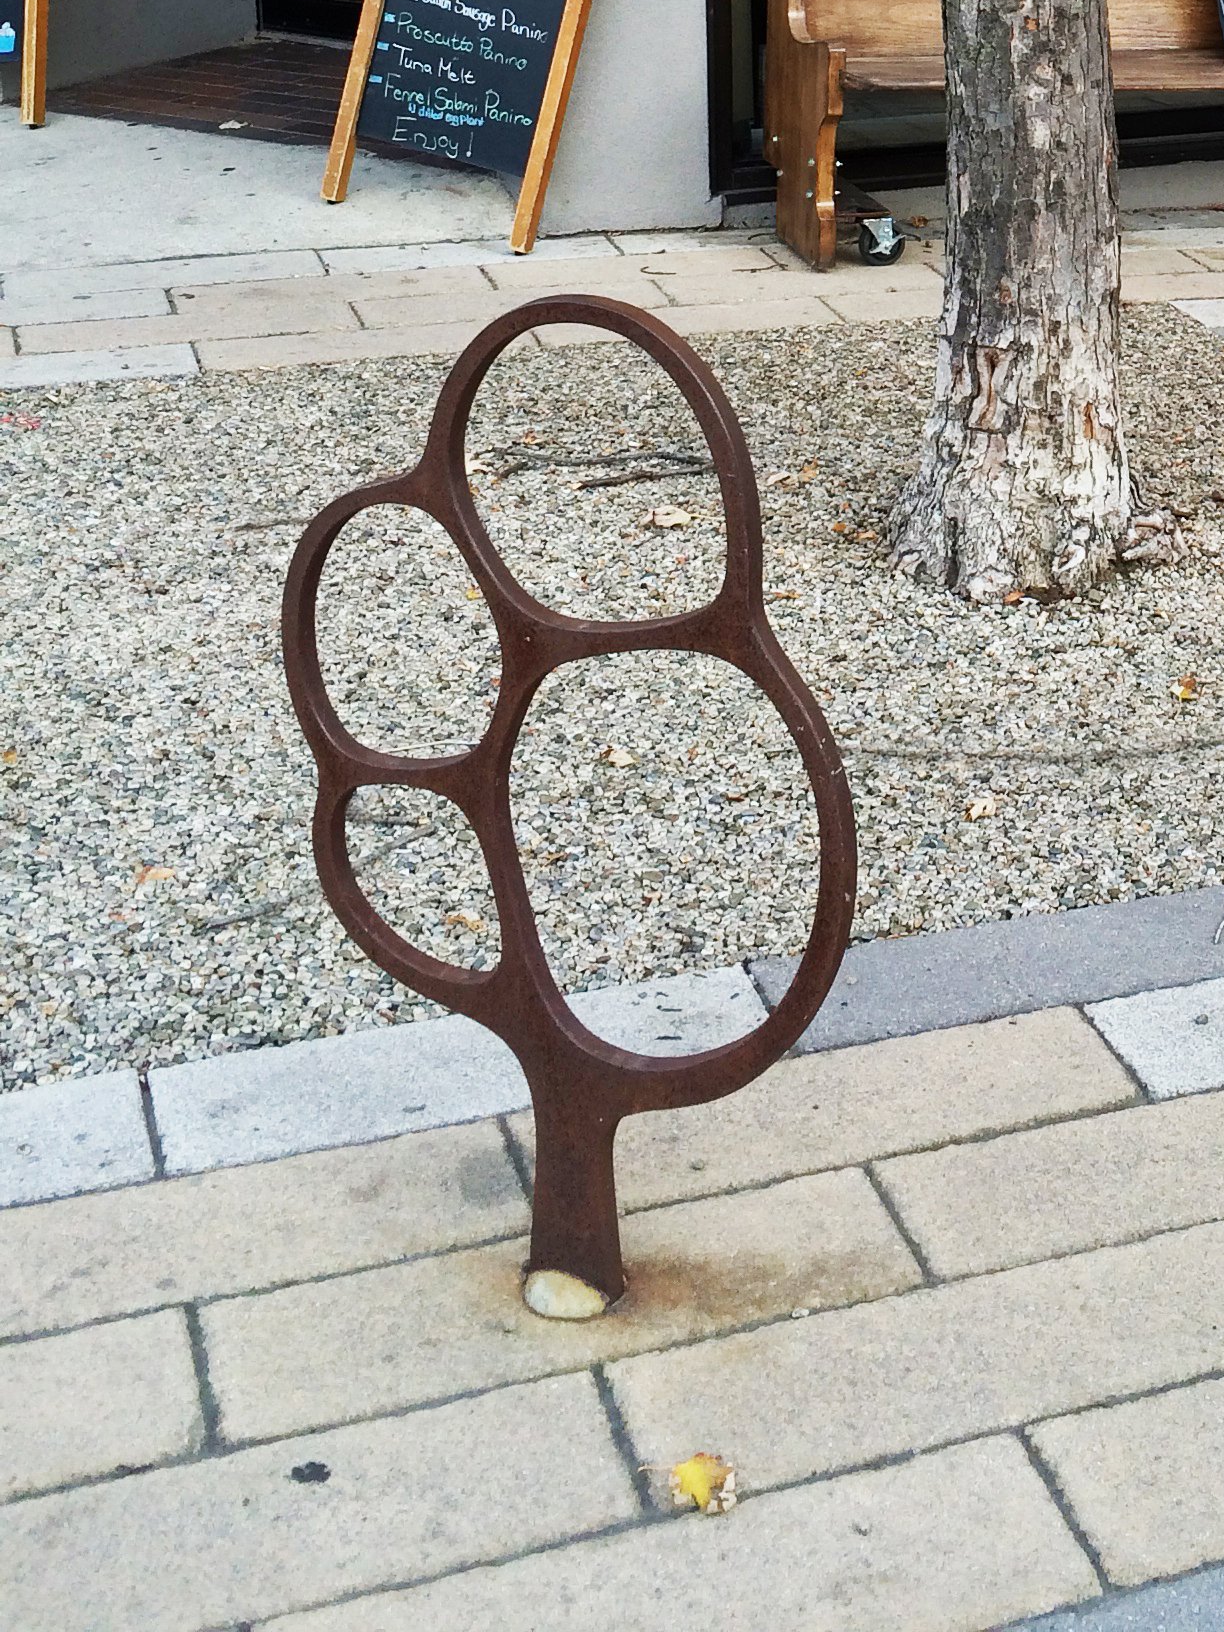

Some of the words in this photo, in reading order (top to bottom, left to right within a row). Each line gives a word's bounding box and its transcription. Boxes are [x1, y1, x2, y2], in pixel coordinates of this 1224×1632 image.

[392, 43, 433, 75] Tuna
[437, 57, 476, 85] Melt
[479, 37, 528, 71] Panino
[485, 89, 533, 126] Panino
